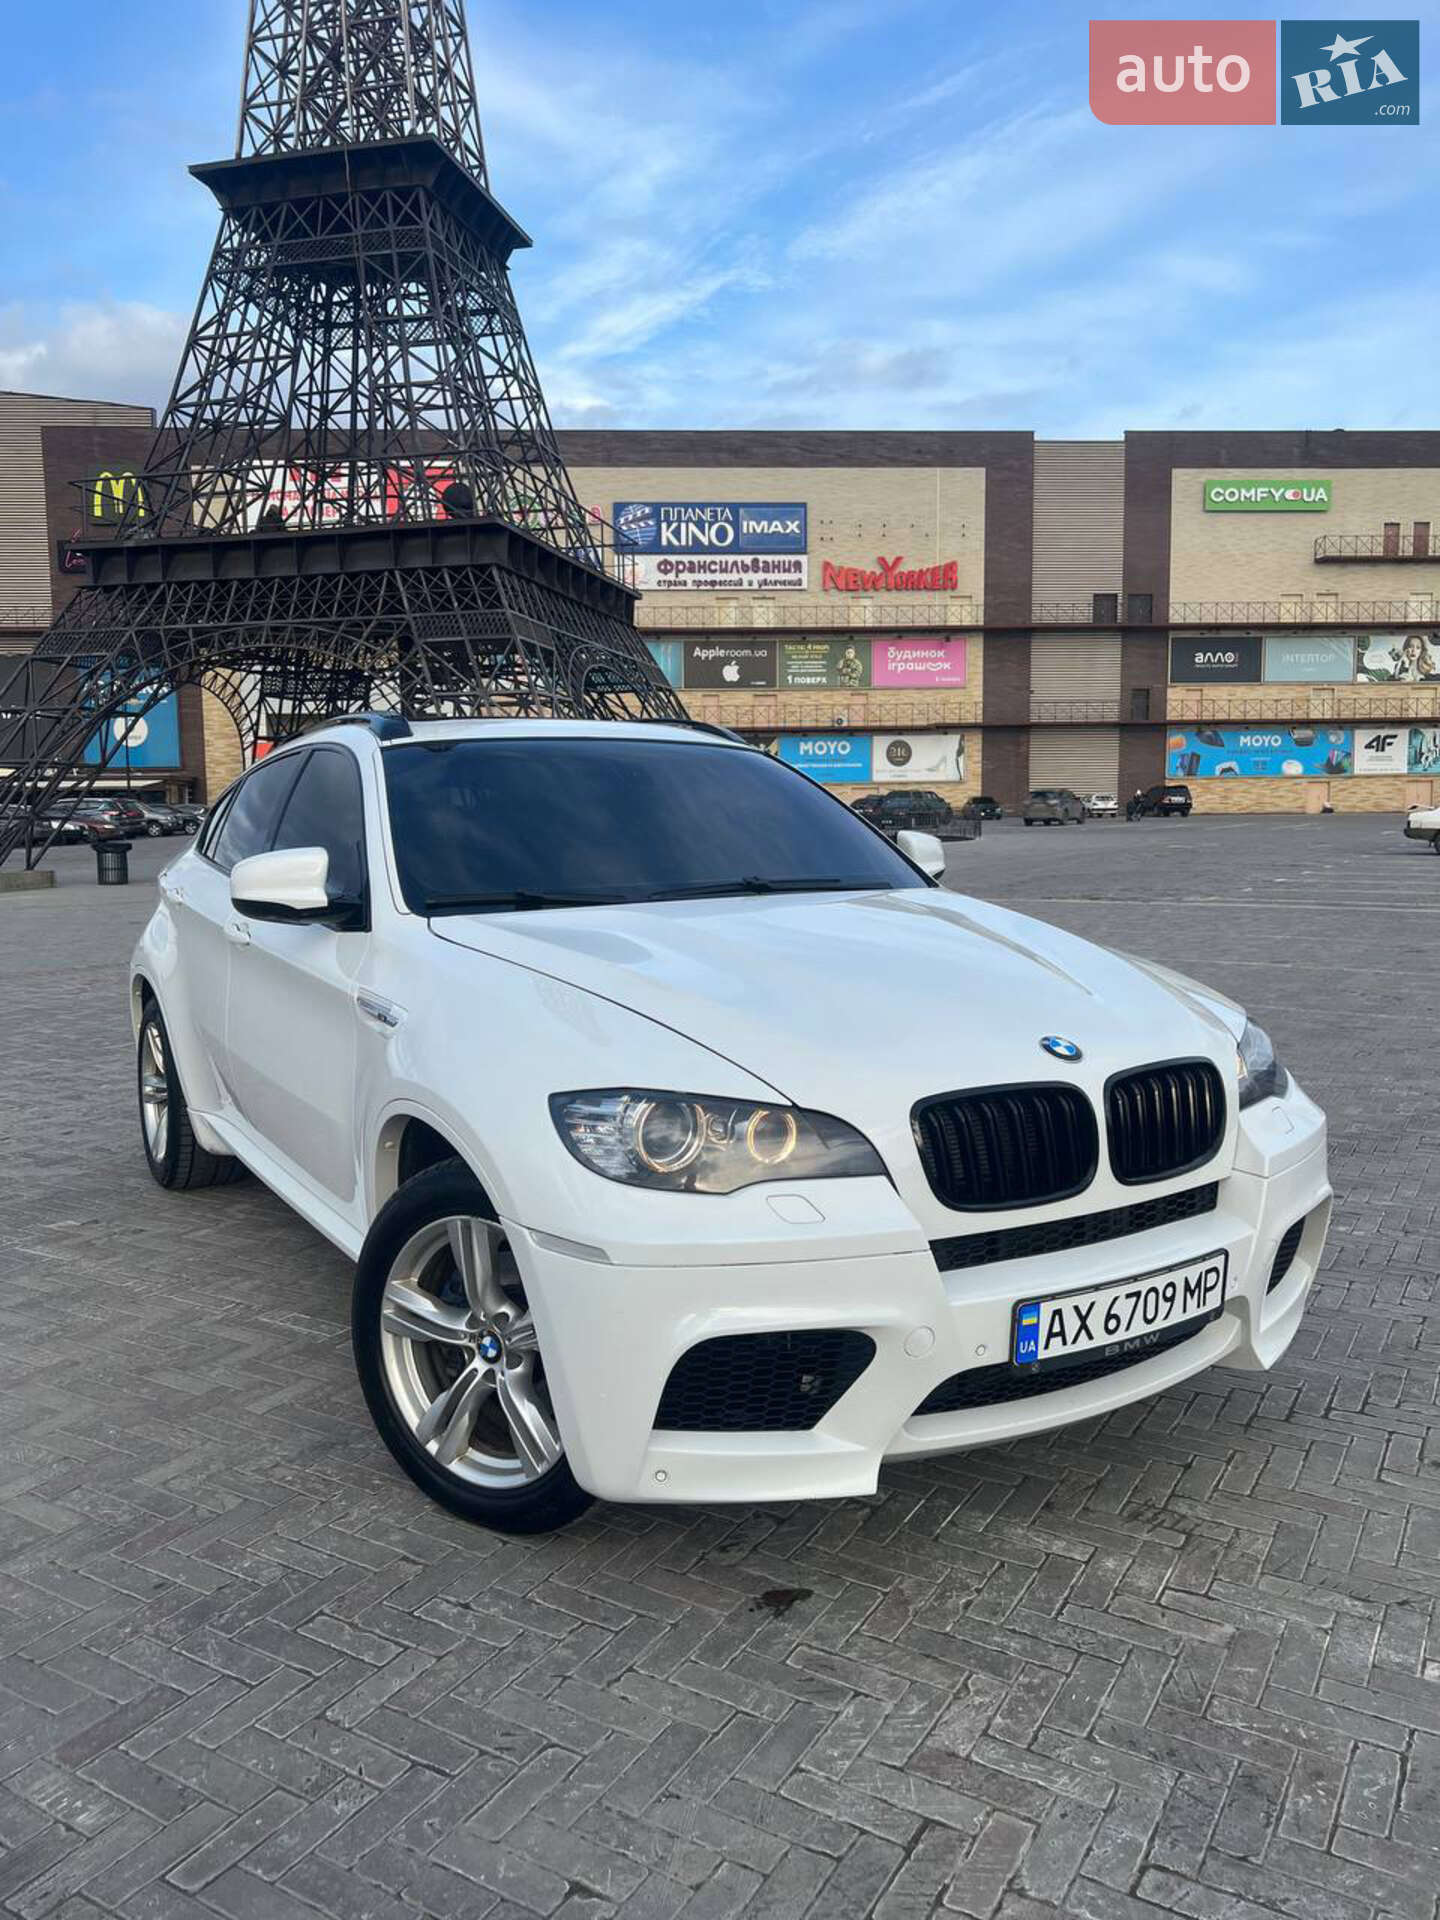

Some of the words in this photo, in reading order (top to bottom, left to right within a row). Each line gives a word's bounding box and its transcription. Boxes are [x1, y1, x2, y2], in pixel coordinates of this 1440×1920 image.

[1210, 487, 1285, 503] COMFY
[661, 521, 734, 547] KINO
[742, 520, 801, 534] IMAX
[656, 557, 802, 578] Франсильвания
[888, 646, 946, 660] будинок
[798, 740, 851, 756] MOYO
[1239, 734, 1283, 747] MOYO
[1043, 1300, 1096, 1350] AX
[1103, 1281, 1177, 1336] 6709
[1182, 1266, 1221, 1314] MP
[1019, 1340, 1037, 1354] UA
